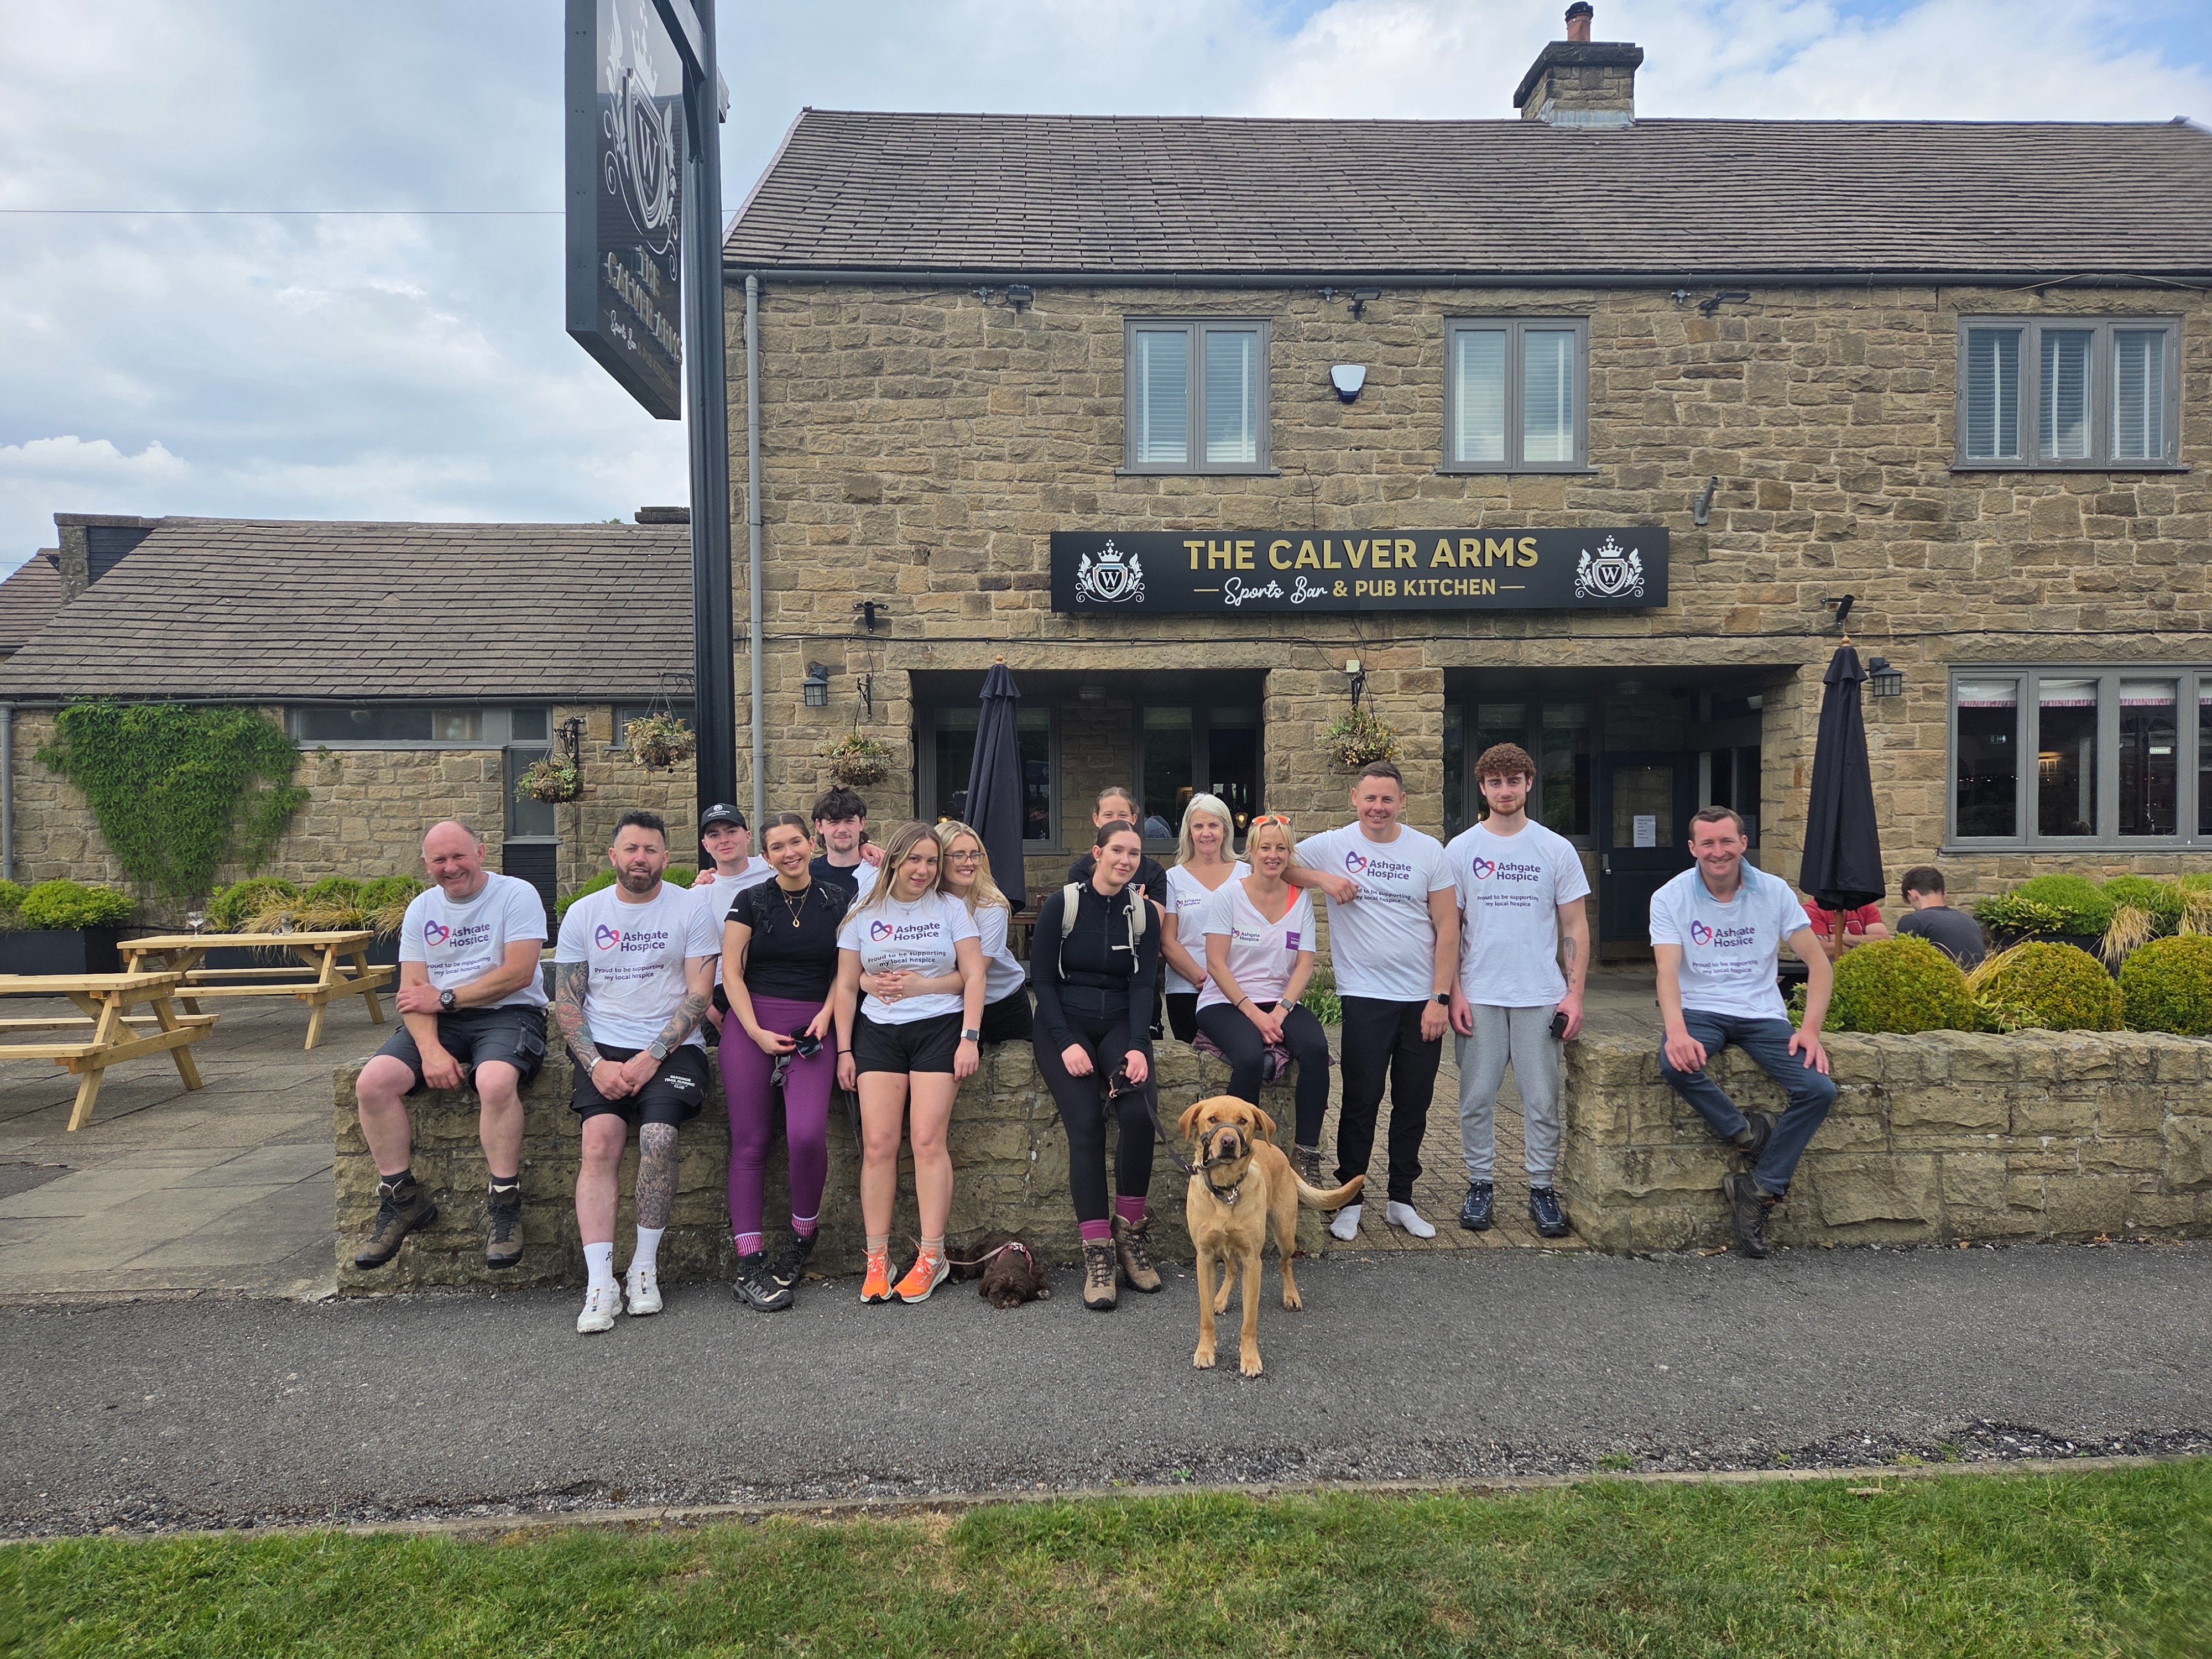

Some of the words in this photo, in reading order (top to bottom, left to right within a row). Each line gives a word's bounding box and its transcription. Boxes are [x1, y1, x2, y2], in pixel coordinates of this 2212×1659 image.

[635, 244, 660, 299] THE
[607, 252, 654, 332] CALVER
[1183, 540, 1255, 570] THE
[1268, 539, 1417, 570] CALVER
[1430, 537, 1539, 568] ARMS
[1100, 571, 1120, 587] W
[1600, 567, 1620, 582] W
[1224, 576, 1284, 607] Sports
[1290, 576, 1328, 604] Bar
[1332, 580, 1348, 597] &
[1355, 580, 1397, 597] PUB
[1403, 578, 1496, 597] KITCHEN
[1369, 859, 1412, 872] Ashgate
[1498, 862, 1541, 873] Ashgate
[1367, 868, 1410, 880] Hospice
[1496, 872, 1539, 883] Hospice
[1379, 891, 1411, 900] supporting
[896, 922, 941, 934] Ashgate
[622, 930, 669, 943] Ashgate
[894, 930, 940, 941] Hospice
[620, 940, 665, 953] Hospice
[868, 954, 886, 964] Proud
[632, 964, 665, 972] supporting
